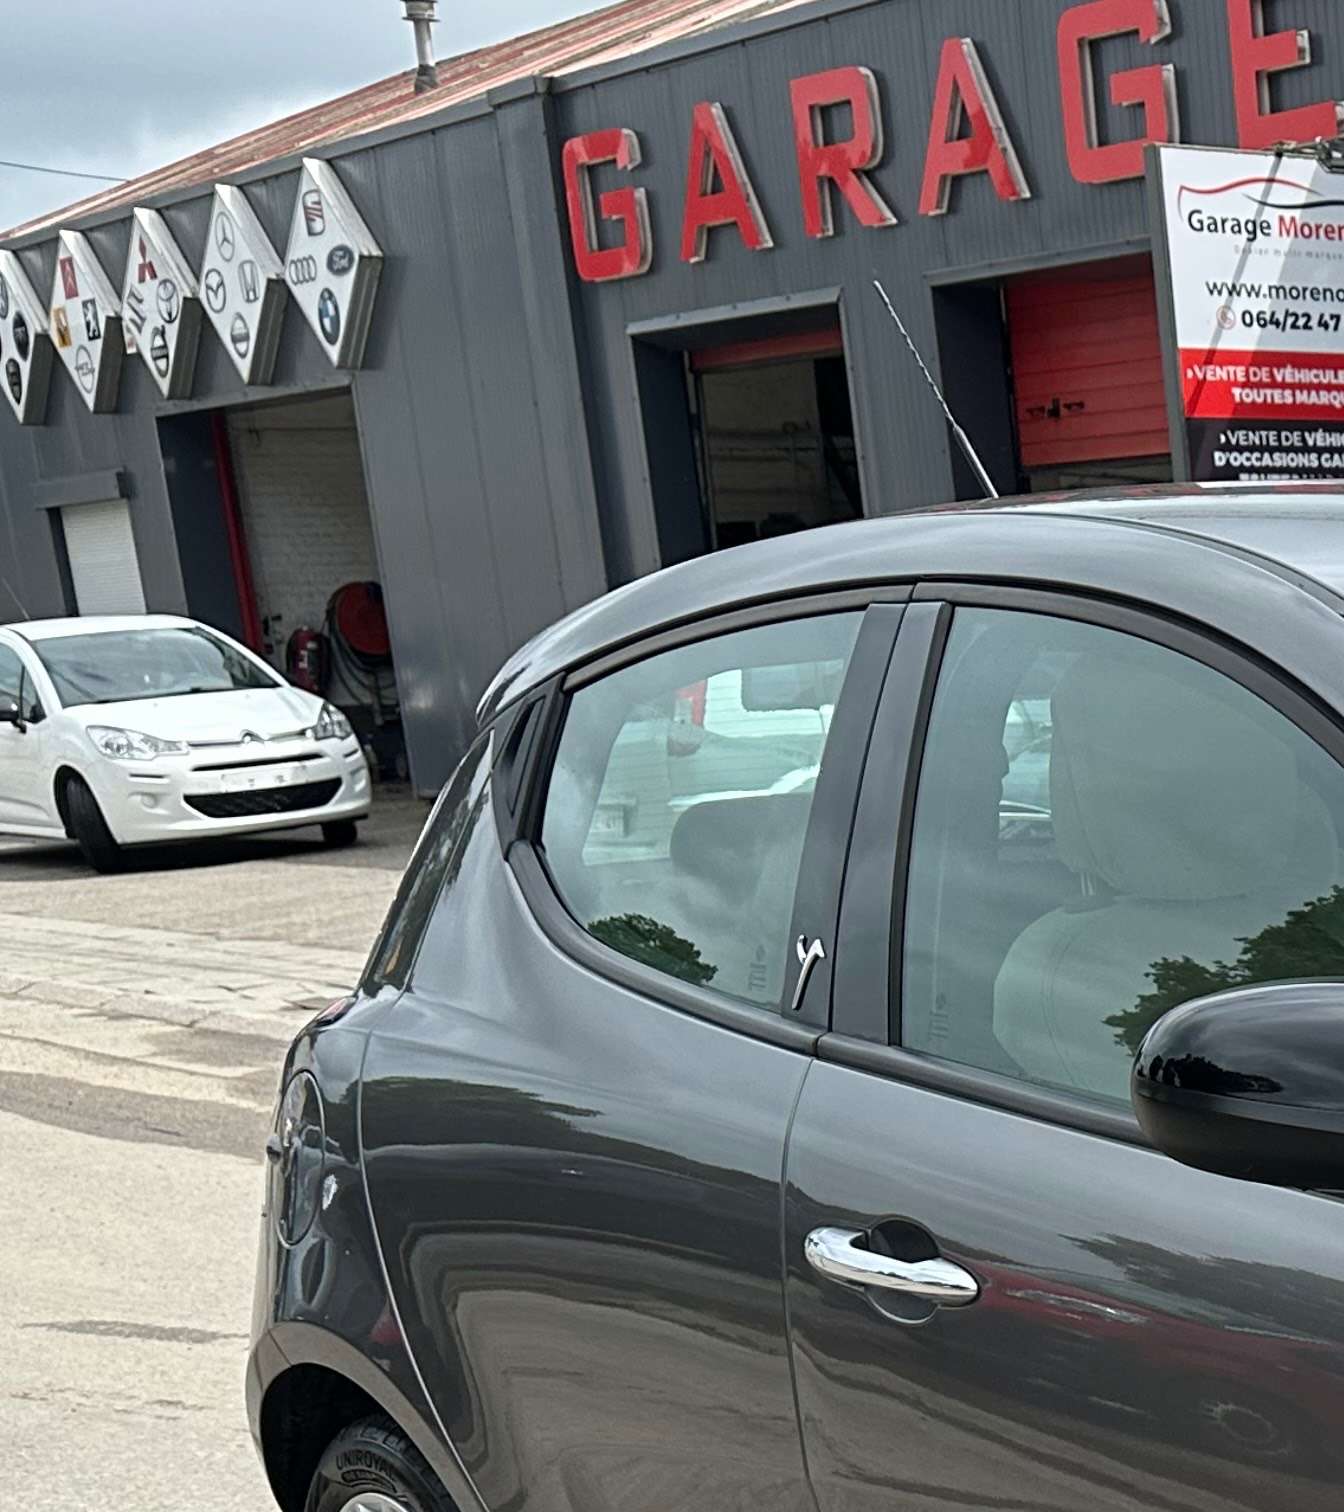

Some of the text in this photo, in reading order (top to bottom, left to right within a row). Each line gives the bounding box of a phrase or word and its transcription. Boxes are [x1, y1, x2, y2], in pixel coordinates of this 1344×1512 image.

[1187, 209, 1272, 242] Garage
[1241, 310, 1313, 332] 064/22
[1317, 312, 1344, 331] 47
[1192, 365, 1247, 382] VENTE
[1249, 366, 1271, 382] DE
[1232, 387, 1292, 404] TOUTES
[1226, 429, 1280, 447] VENTE
[1281, 431, 1303, 447] DE
[1213, 450, 1319, 468] D'OCCASIONS
